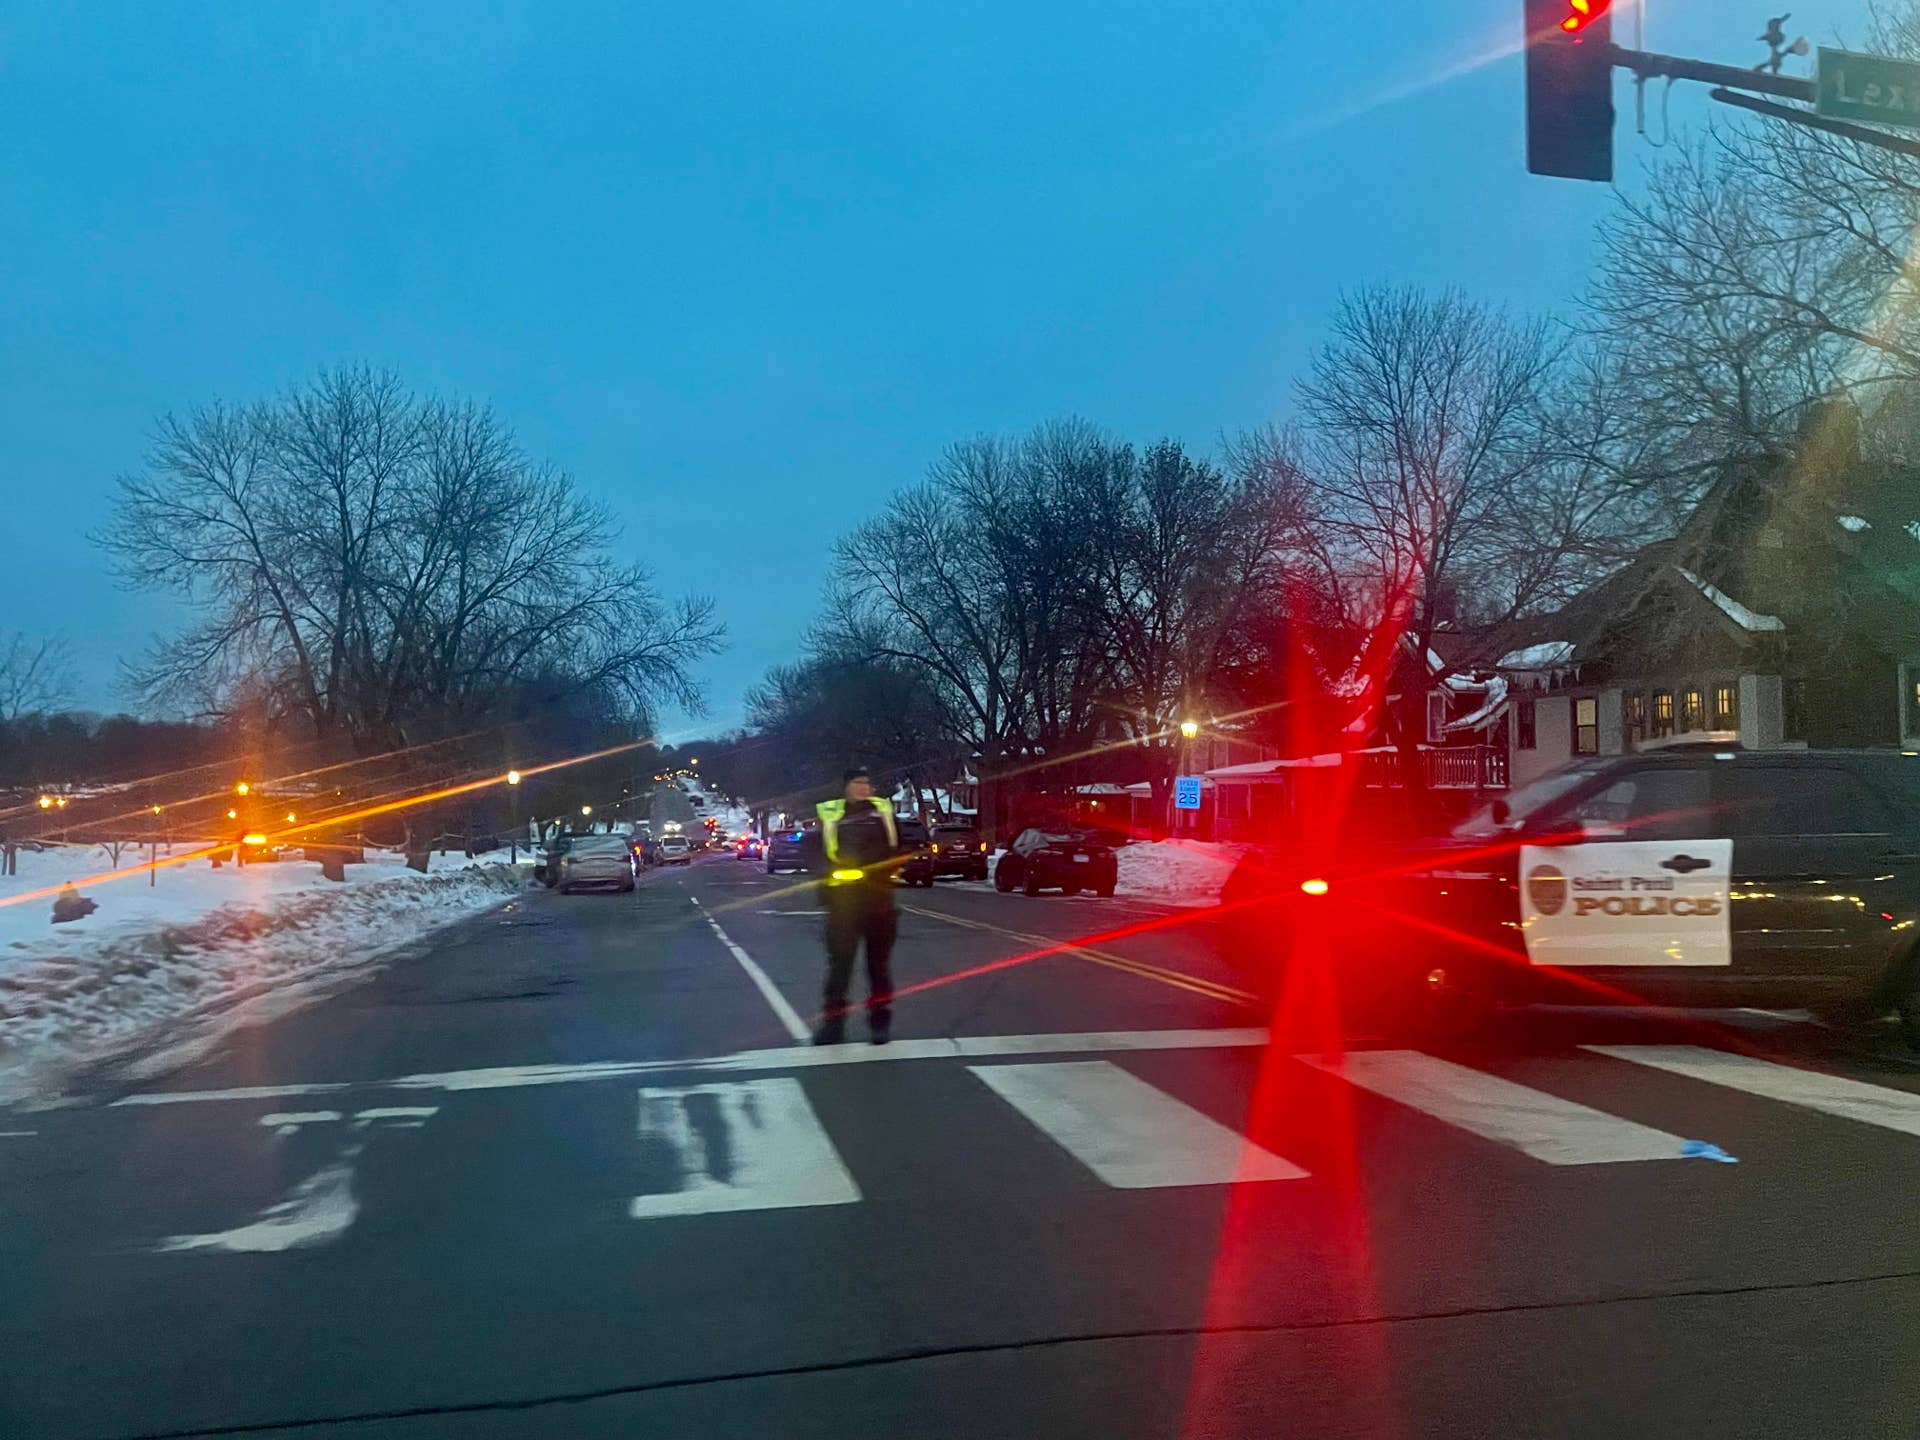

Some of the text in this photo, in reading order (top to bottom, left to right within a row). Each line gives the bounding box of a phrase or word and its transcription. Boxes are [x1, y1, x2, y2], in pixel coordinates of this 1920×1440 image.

[1179, 792, 1198, 804] 25
[1571, 876, 1675, 891] Saint Paul
[1573, 896, 1722, 916] POLICE
